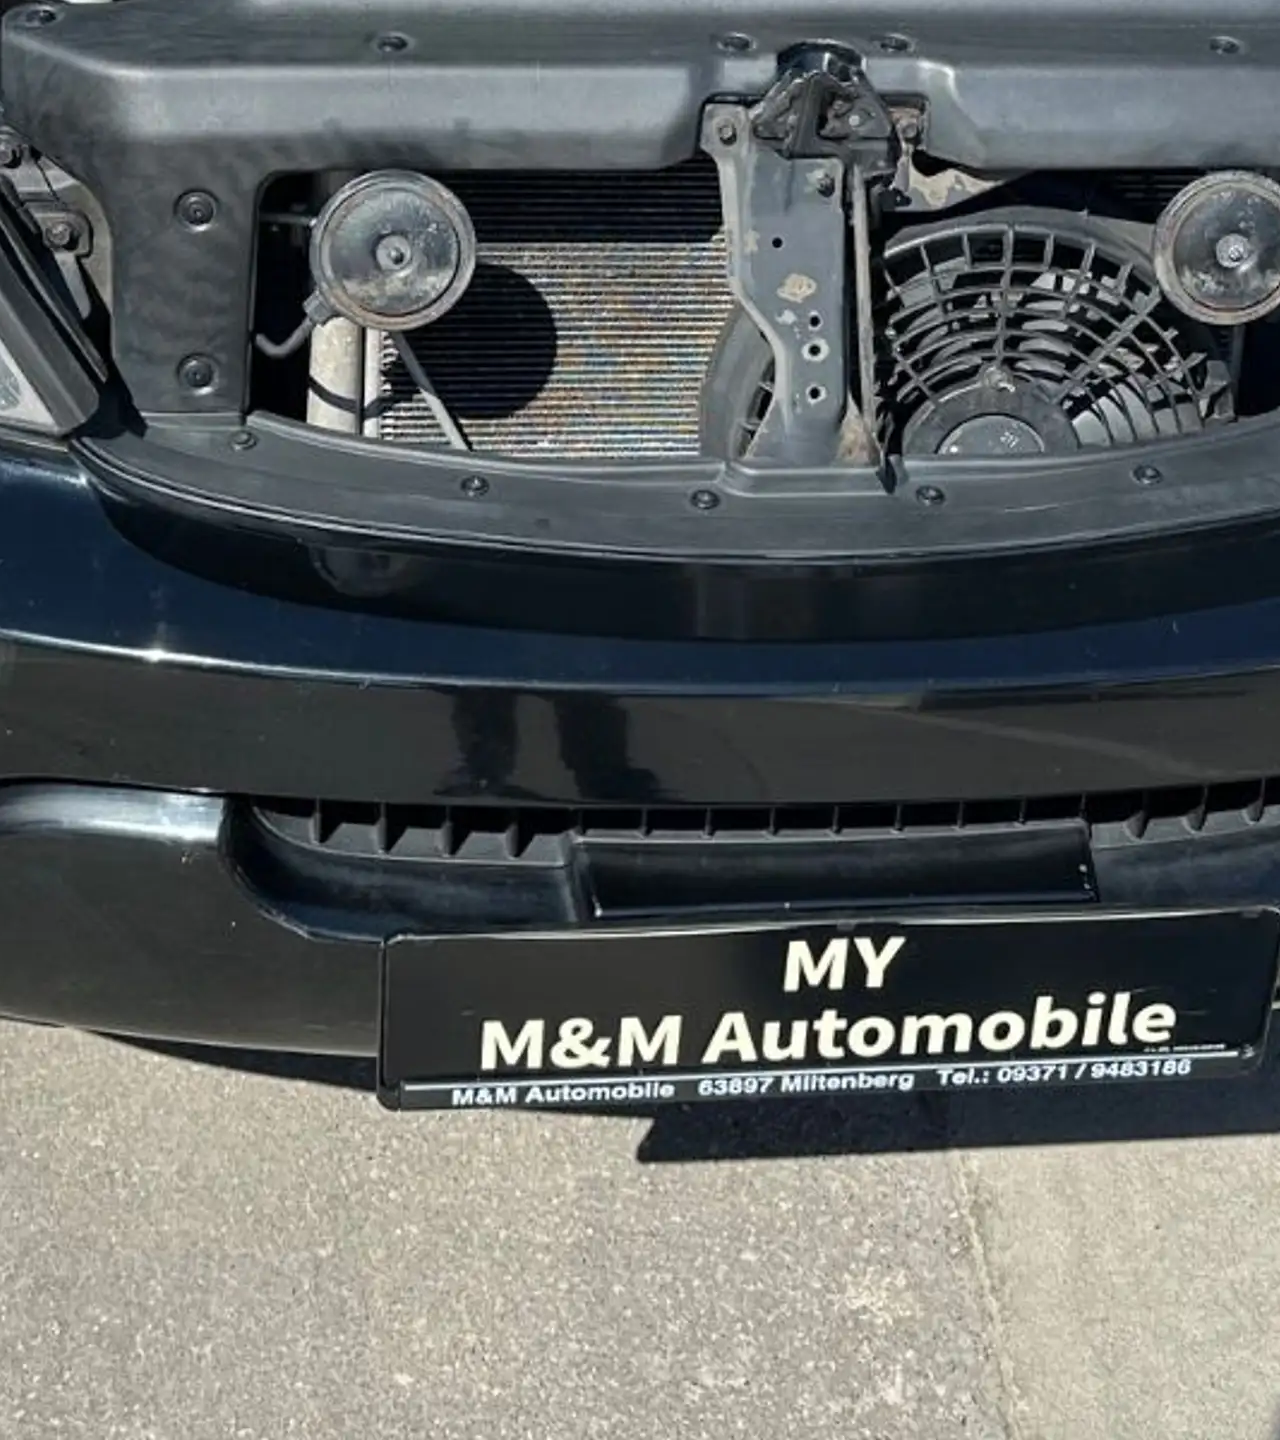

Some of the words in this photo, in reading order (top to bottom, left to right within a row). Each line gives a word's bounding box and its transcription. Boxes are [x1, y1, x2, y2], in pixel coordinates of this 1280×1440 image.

[782, 936, 905, 993] MY
[480, 1015, 683, 1071] M&M
[701, 992, 1177, 1066] Automobile
[451, 1086, 518, 1107] M&M
[524, 1081, 676, 1104] Automobile
[697, 1076, 774, 1096] 63897
[779, 1071, 915, 1092] Miltenberg
[935, 1067, 990, 1086] Tel.:
[996, 1063, 1068, 1084] 09371
[1074, 1063, 1085, 1080] /
[1090, 1058, 1192, 1079] 9483186
